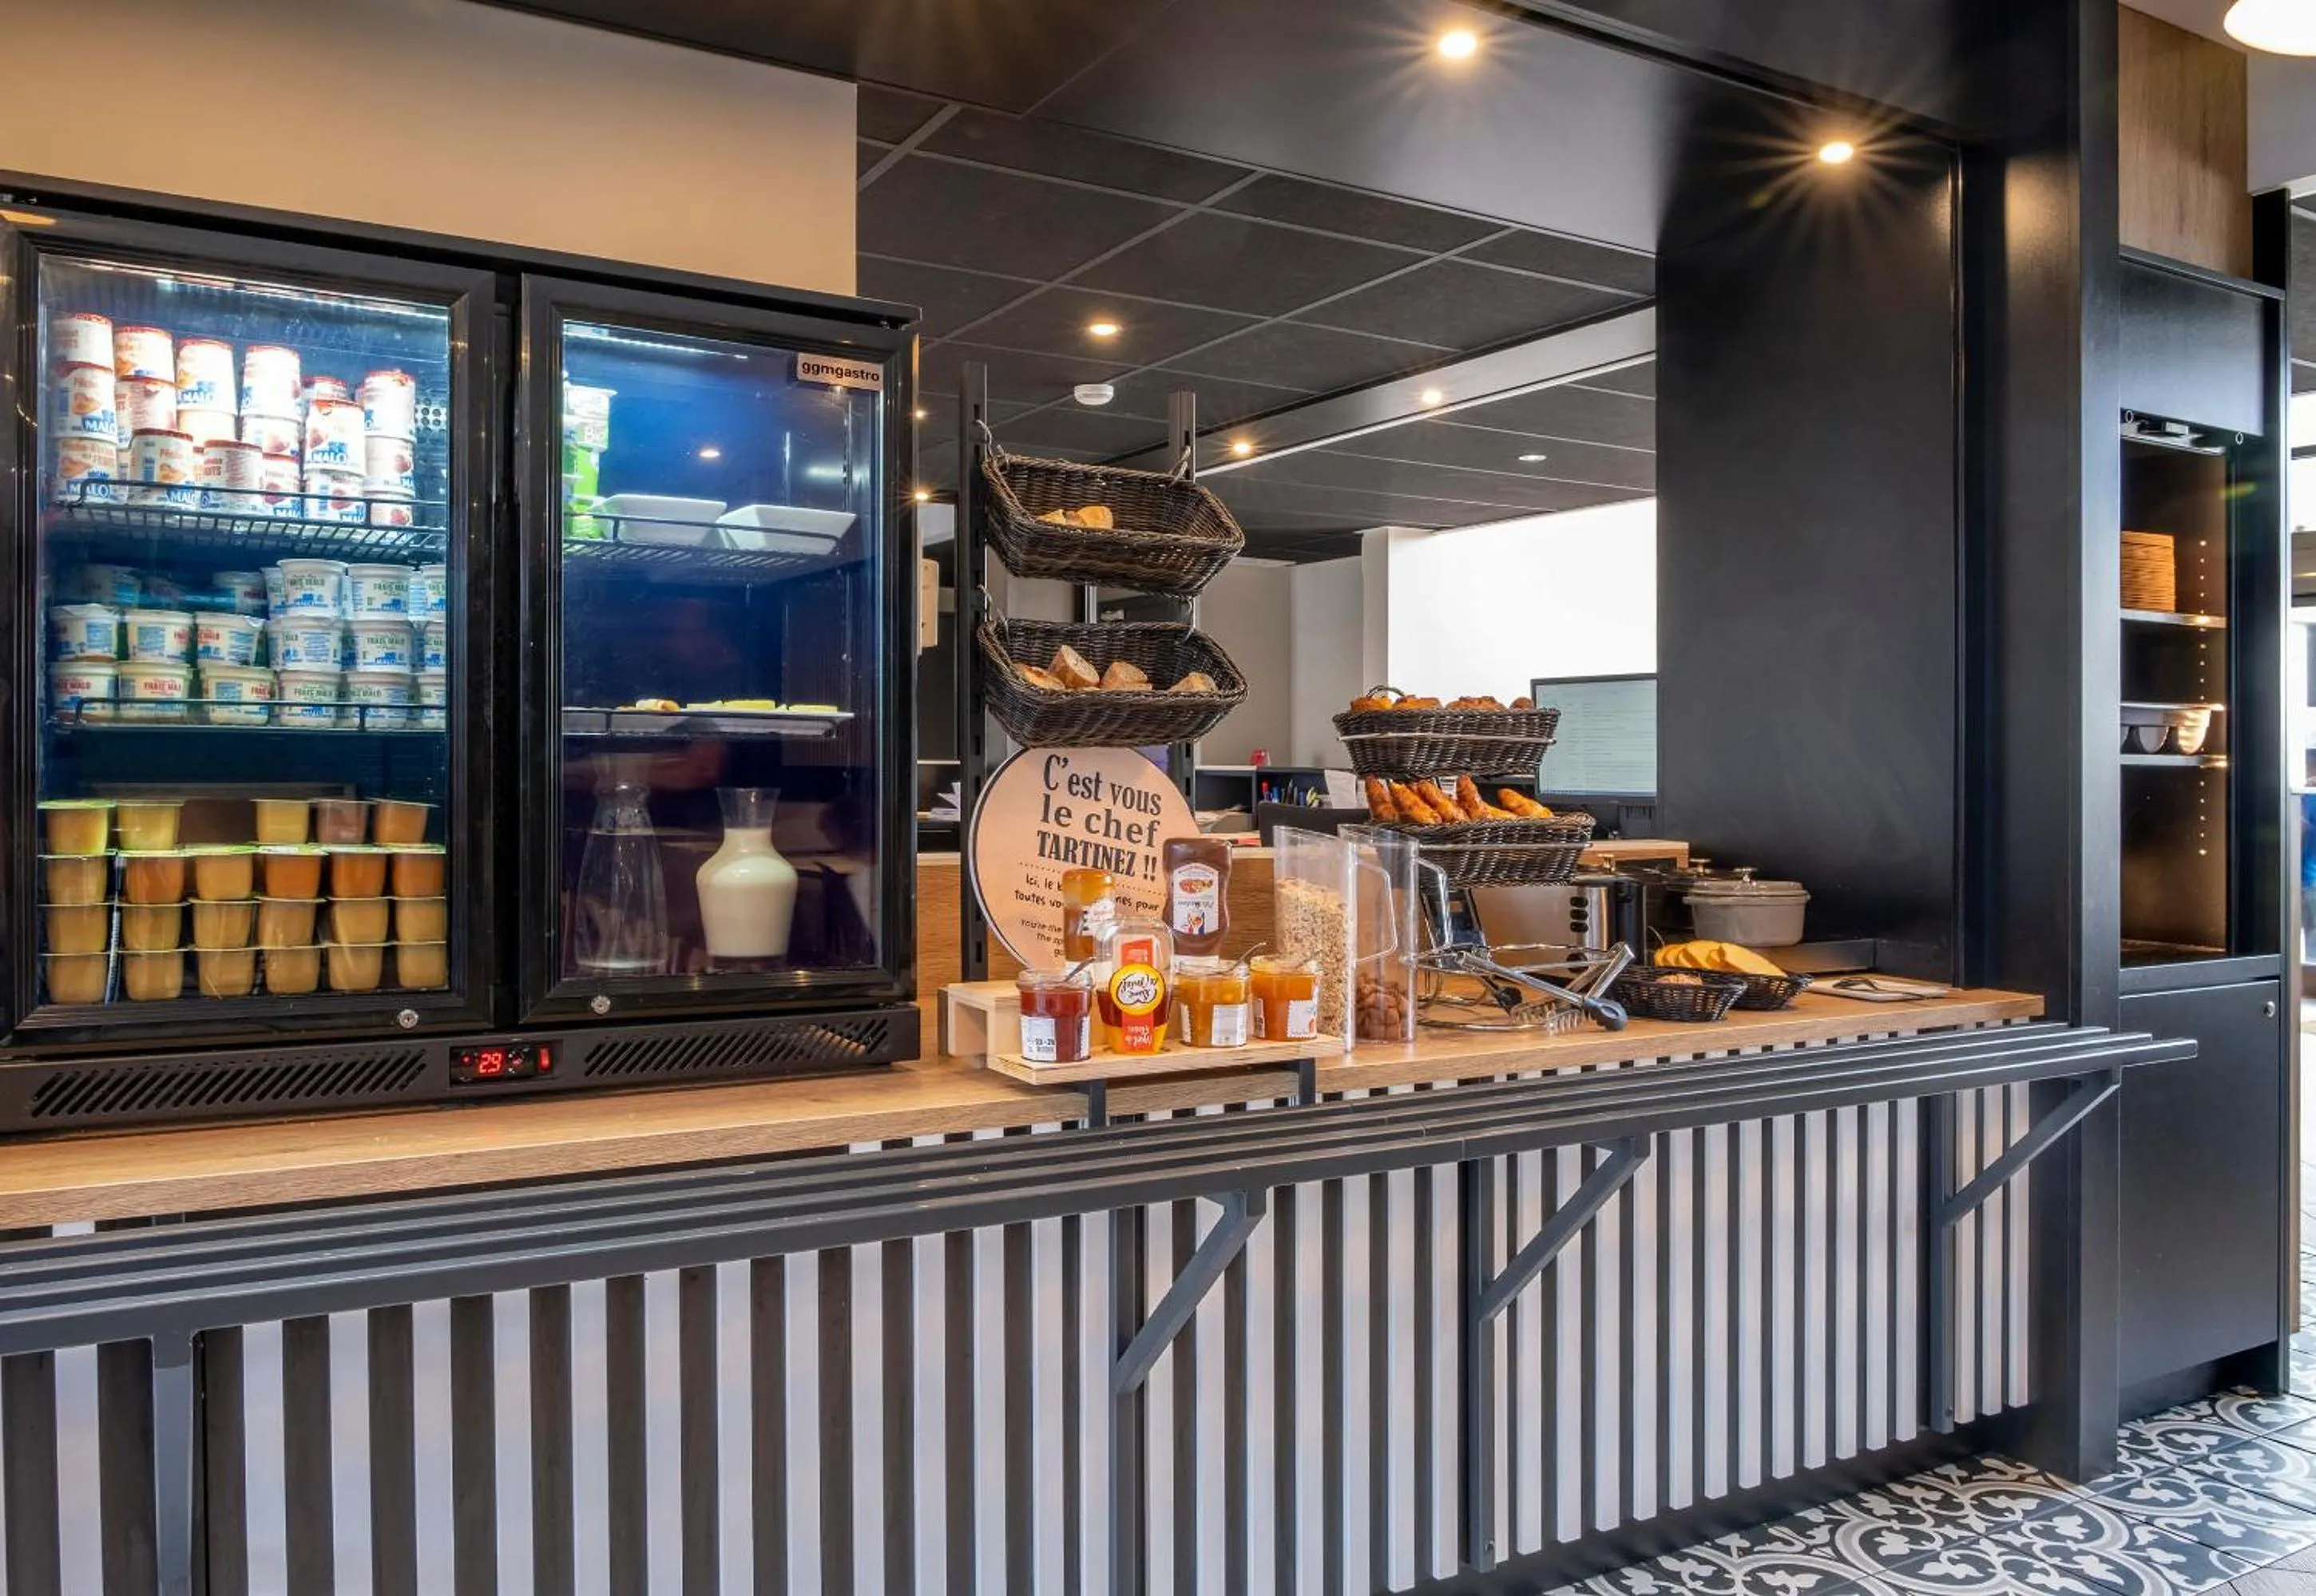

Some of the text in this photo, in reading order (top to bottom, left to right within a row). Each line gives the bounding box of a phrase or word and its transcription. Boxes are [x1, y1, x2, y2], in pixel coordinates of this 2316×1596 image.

[802, 362, 879, 382] ggmgastro
[1043, 754, 1161, 816] C'est vous
[1040, 793, 1160, 848] le chef
[1037, 830, 1136, 877] TARTINEZ
[1136, 901, 1159, 912] pour
[479, 1053, 502, 1073] 29
